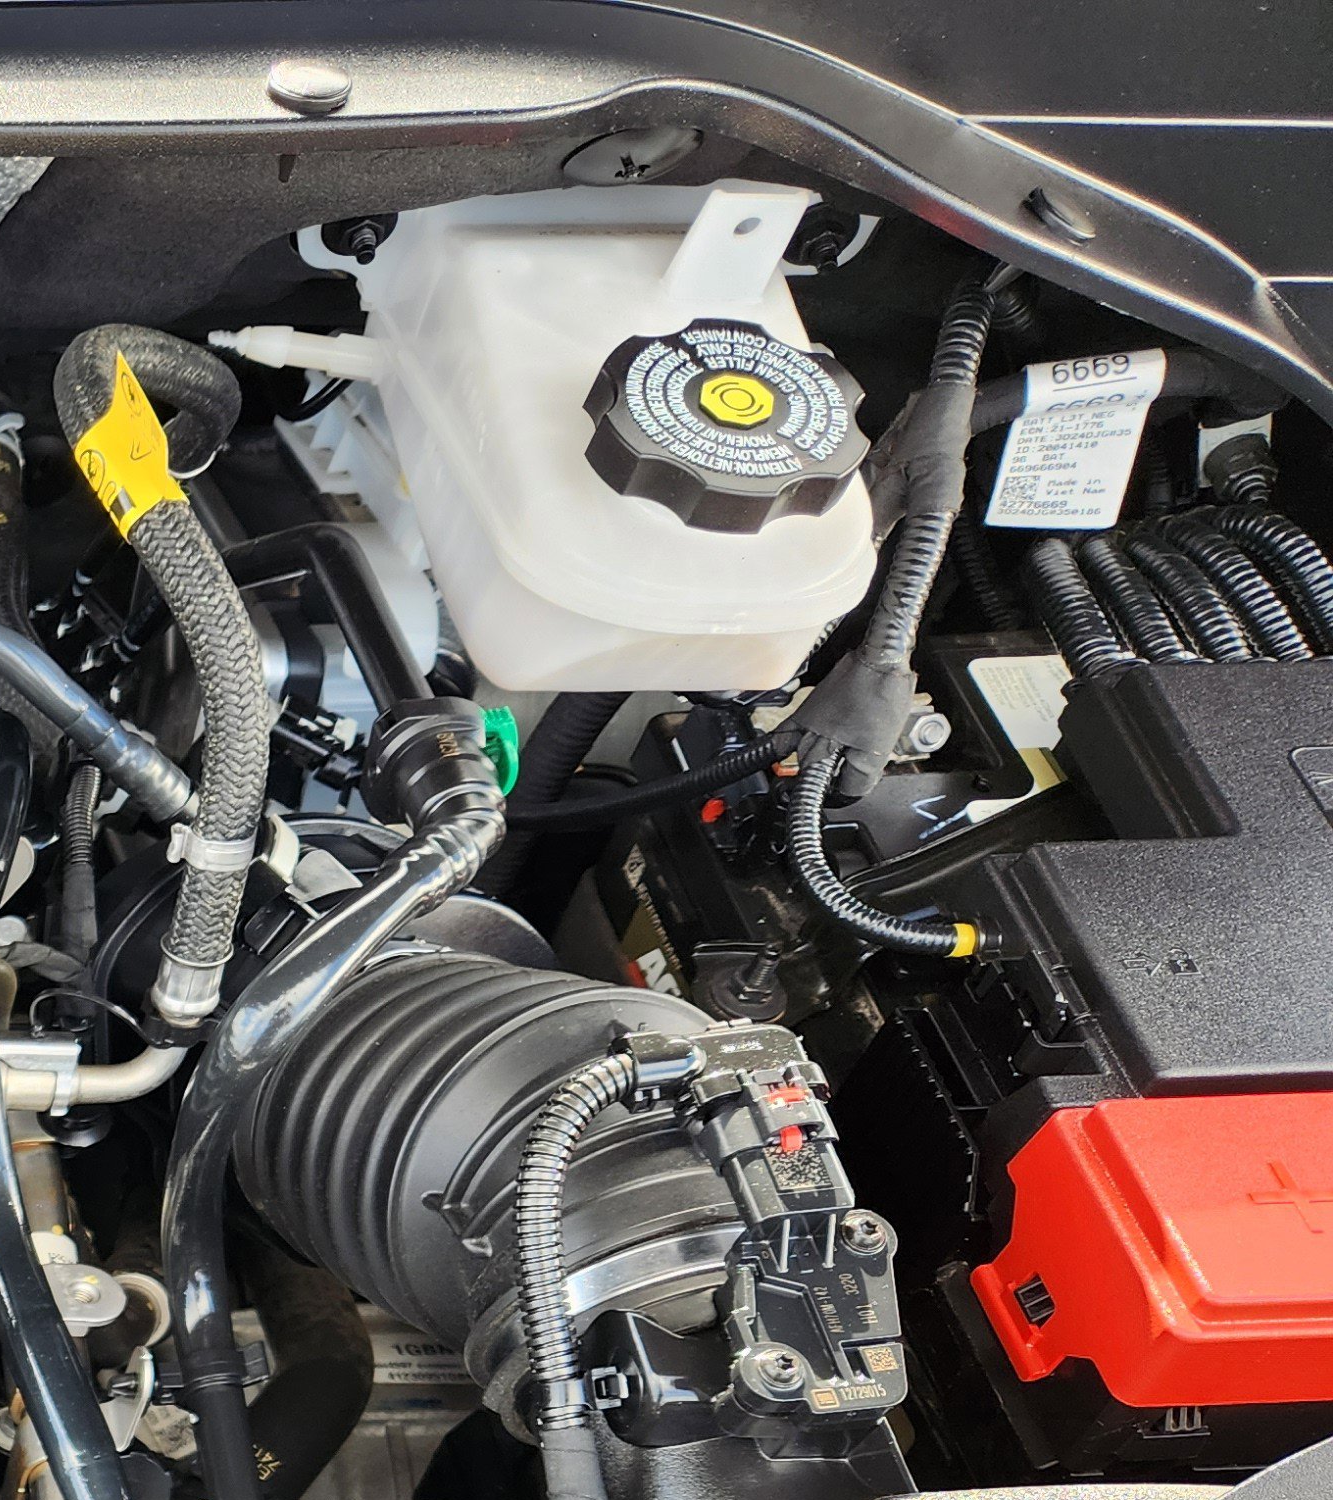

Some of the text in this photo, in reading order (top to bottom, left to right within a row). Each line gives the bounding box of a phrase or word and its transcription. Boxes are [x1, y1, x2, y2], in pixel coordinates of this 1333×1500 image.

[657, 352, 684, 370] DOT
[695, 343, 732, 358] ONLY
[733, 343, 762, 360] USE
[764, 339, 821, 374] SEALED
[701, 355, 756, 372] FILLER
[1052, 355, 1130, 384] 6669
[624, 366, 647, 395] AVANT
[645, 364, 671, 389] FREIN
[753, 362, 800, 393] CLEAN
[645, 387, 664, 400] DE
[666, 388, 689, 415] BIDON
[817, 377, 846, 406] FROM
[626, 394, 662, 435] BOUCHON
[648, 400, 682, 432] LIQUIDE
[806, 393, 827, 432] BEFORE
[827, 408, 847, 437] FLUID
[1022, 415, 1054, 427] BATT
[1091, 410, 1116, 420] NEG
[650, 430, 675, 446] LE
[672, 427, 695, 442] DU
[687, 434, 718, 454] QUE
[698, 425, 778, 447] PROVENANT
[791, 427, 822, 450] CAP
[665, 439, 732, 472] NETTOYER
[807, 437, 839, 461] DOT
[1042, 452, 1066, 462] BAT
[1045, 486, 1106, 496] Viet Nam
[1047, 477, 1101, 487] Made in
[839, 1383, 887, 1401] 12729015
